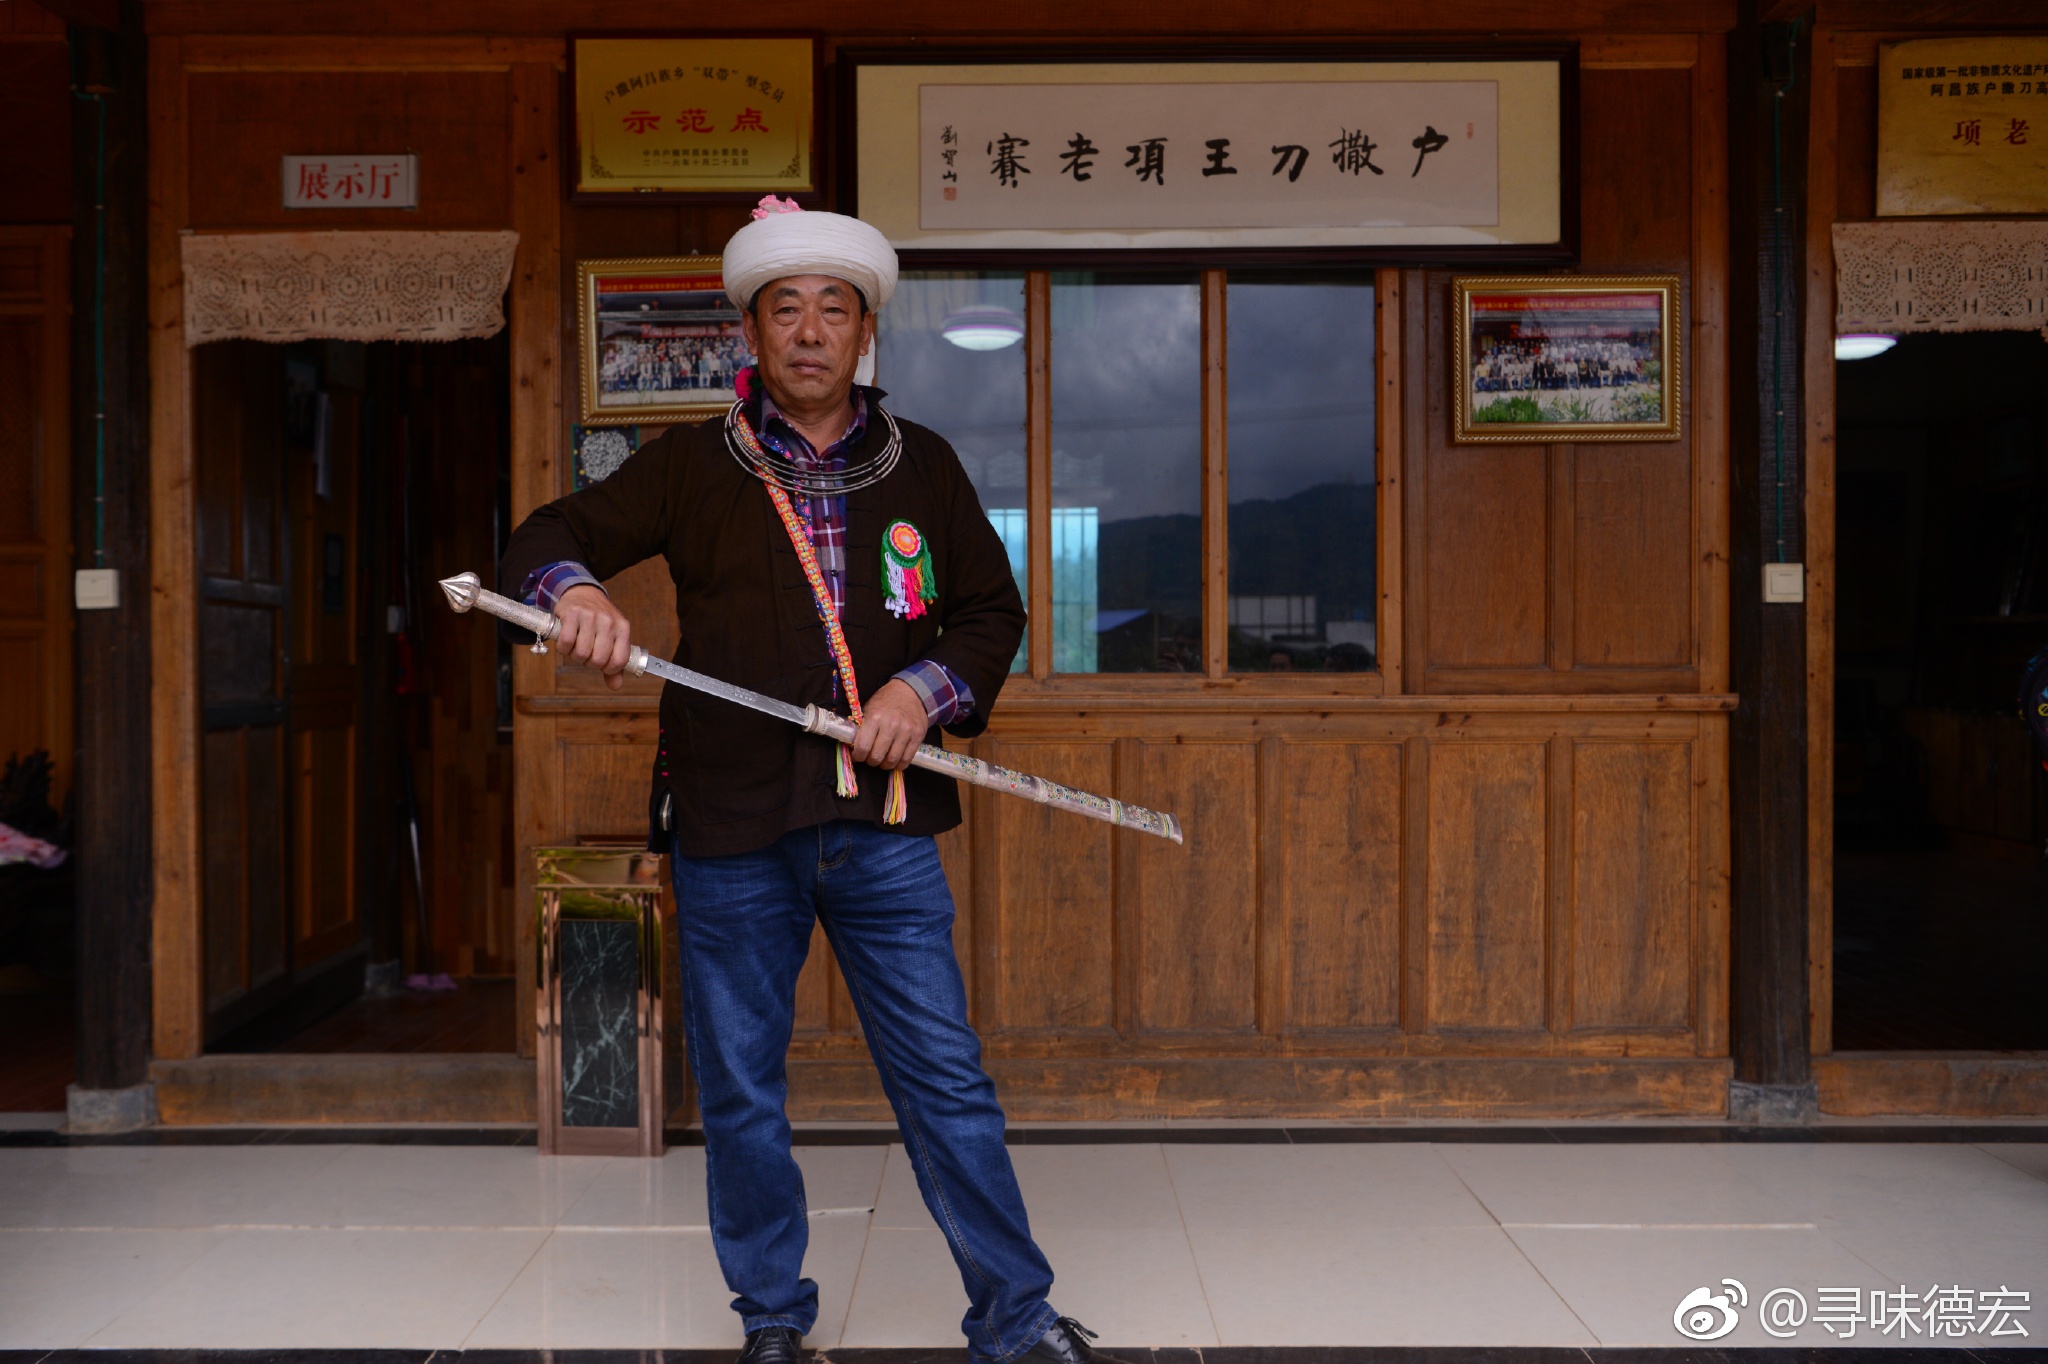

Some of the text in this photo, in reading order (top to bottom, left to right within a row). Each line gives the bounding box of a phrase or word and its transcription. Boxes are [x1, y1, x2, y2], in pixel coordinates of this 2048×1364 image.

[622, 107, 769, 134] 示范点
[1952, 118, 2029, 145] 项老
[297, 163, 399, 200] 展示厅
